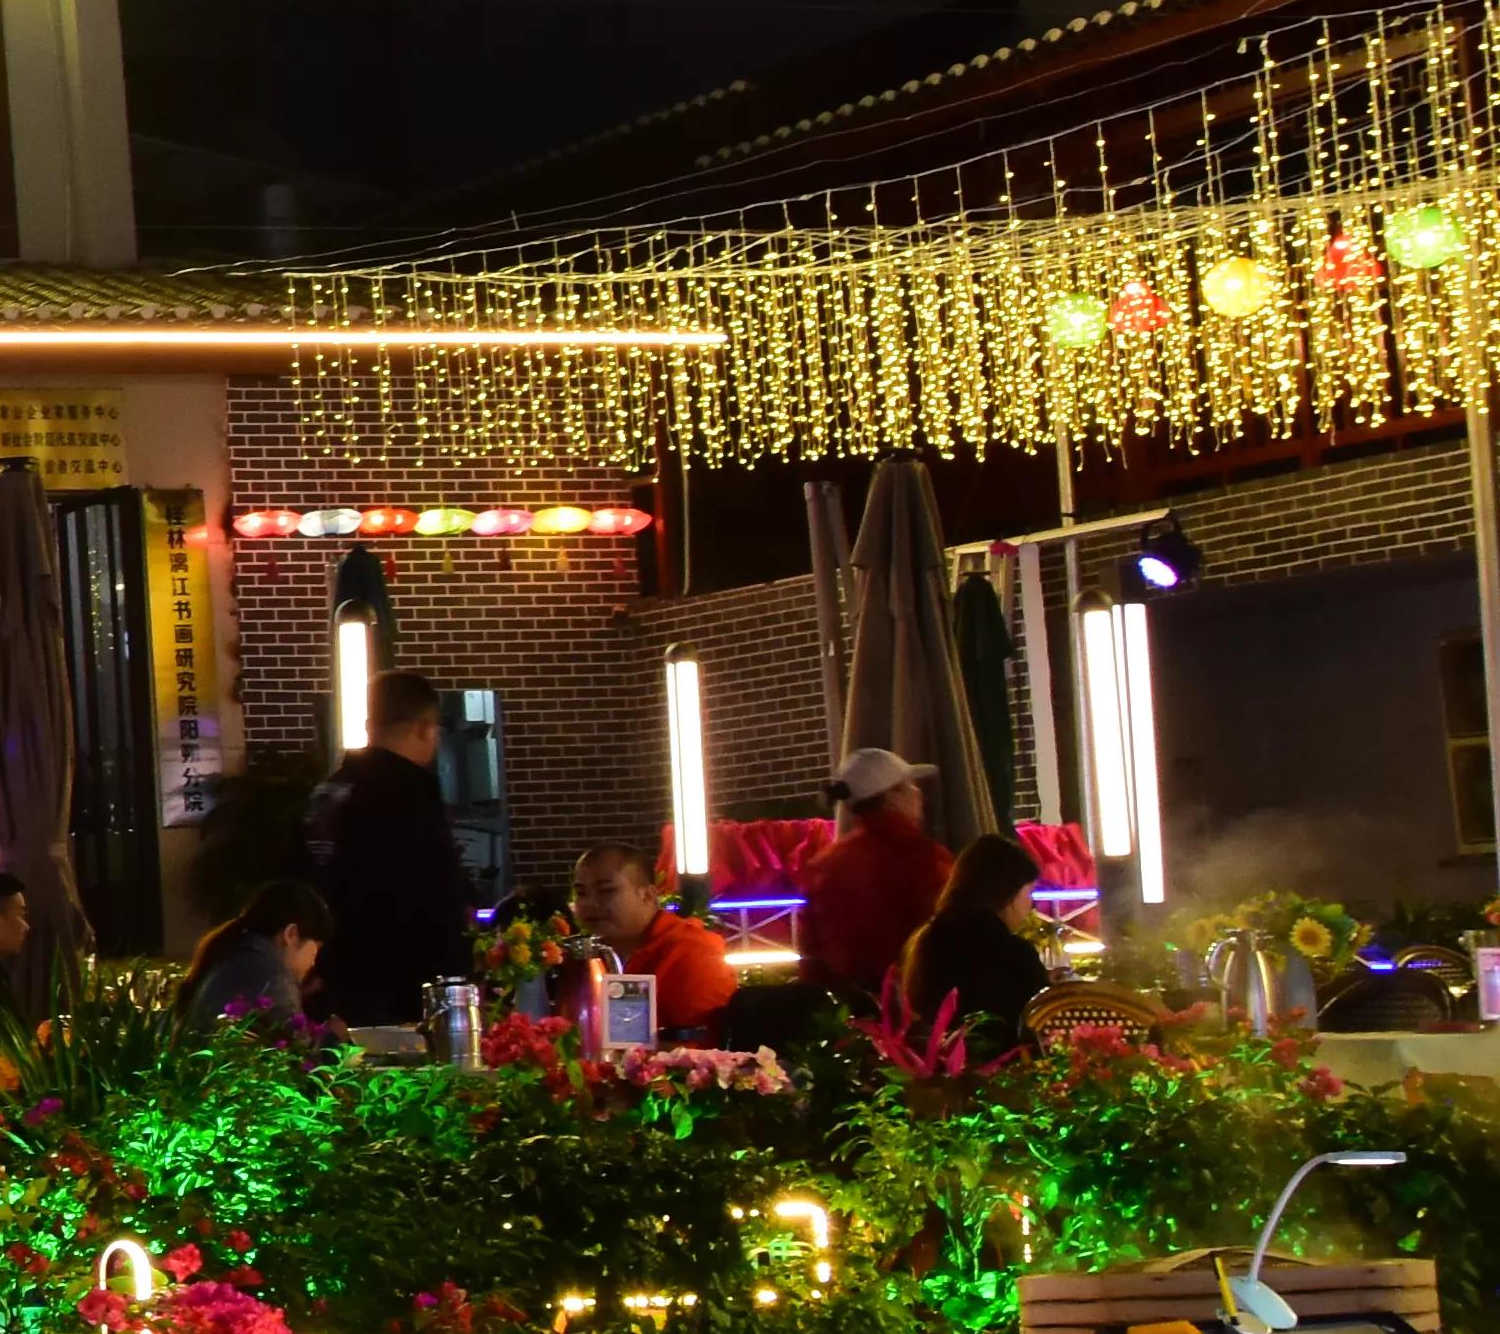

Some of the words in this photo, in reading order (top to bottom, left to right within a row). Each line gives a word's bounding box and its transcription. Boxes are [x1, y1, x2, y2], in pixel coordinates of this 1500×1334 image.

[166, 505, 204, 812] 桂林漓江书画研究院阳朔分院
